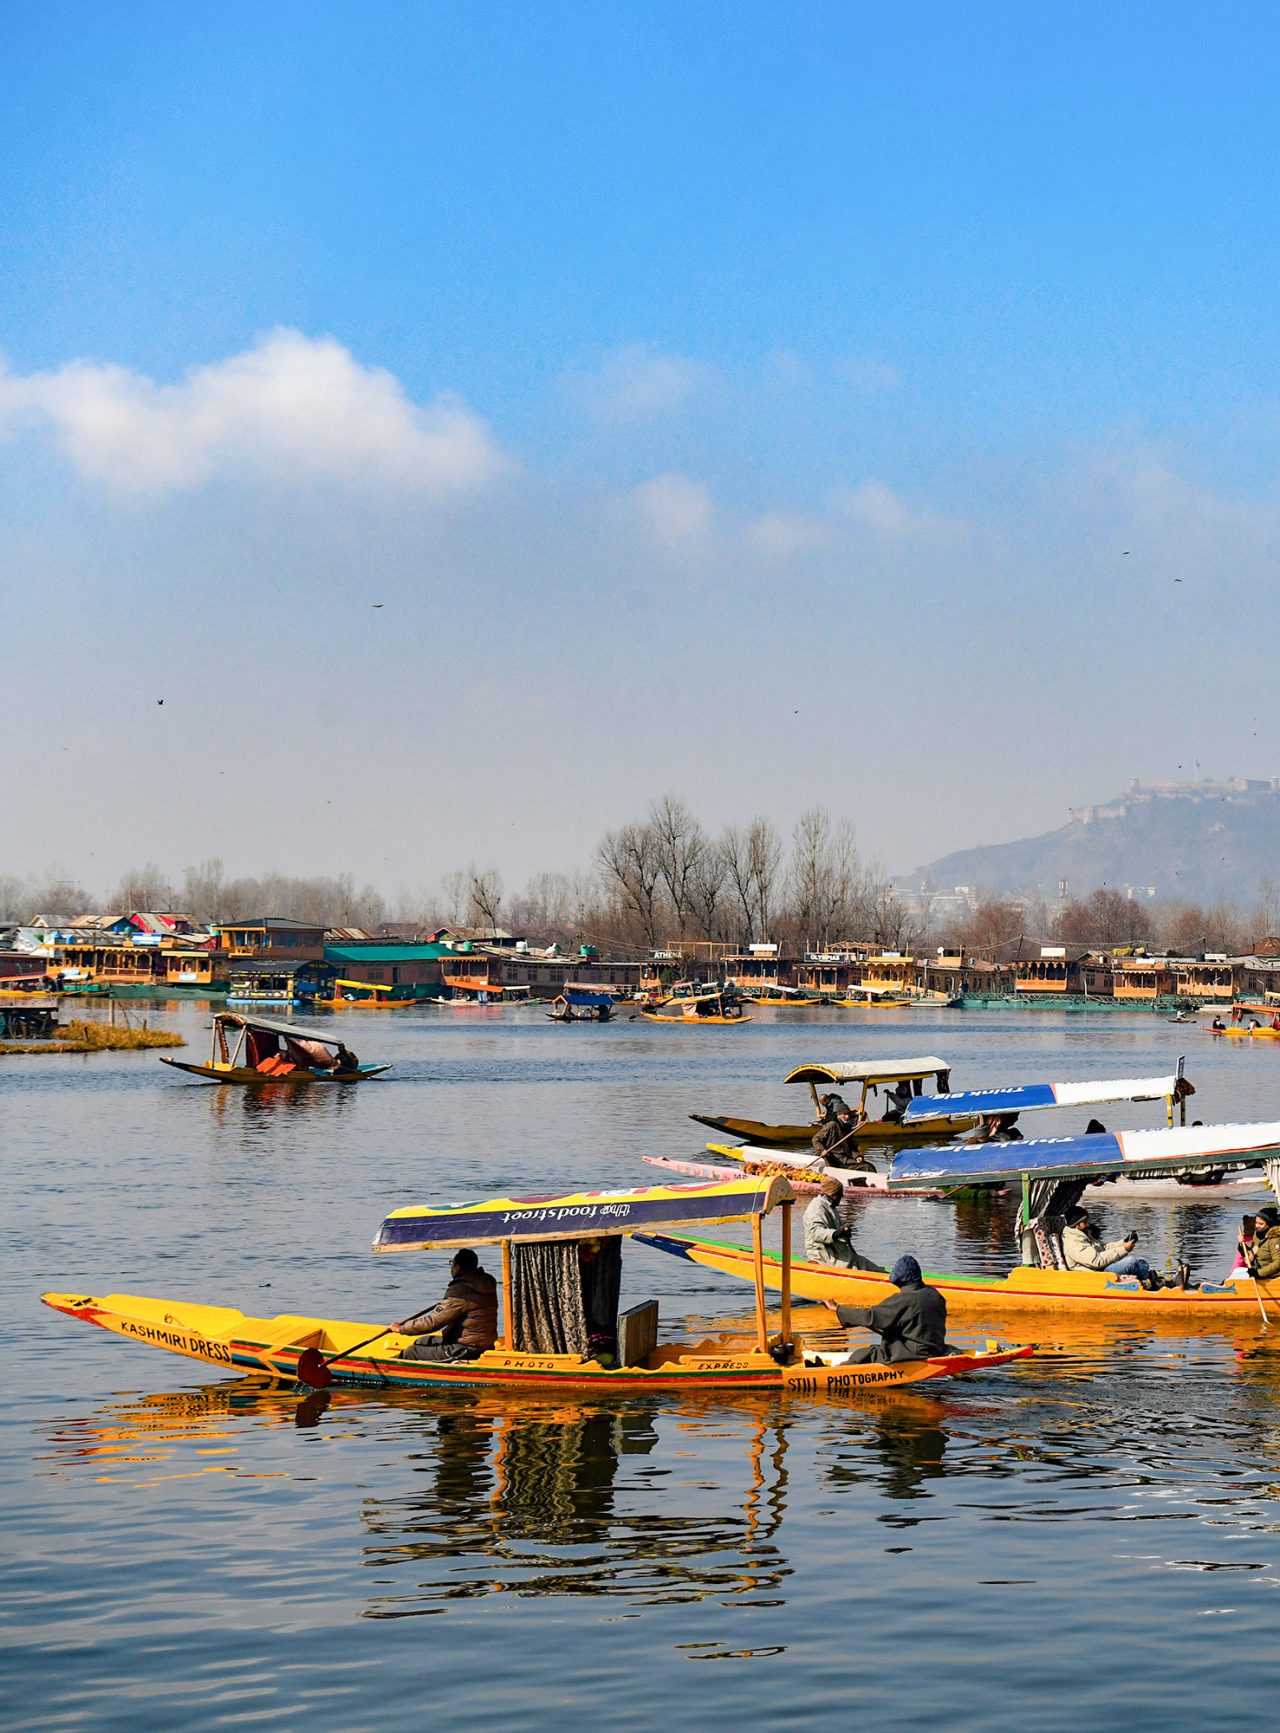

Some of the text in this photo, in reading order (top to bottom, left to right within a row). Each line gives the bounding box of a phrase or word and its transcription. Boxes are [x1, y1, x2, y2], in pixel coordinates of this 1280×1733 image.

[654, 951, 682, 959] ATHENA
[969, 1086, 1025, 1097] Think
[600, 1203, 630, 1217] the
[121, 1321, 231, 1362] KASHMIRI DRESS
[503, 1359, 555, 1369] PHOTO
[698, 1361, 750, 1371] EXPRESS
[826, 1370, 905, 1391] PHOTOGRAPHY
